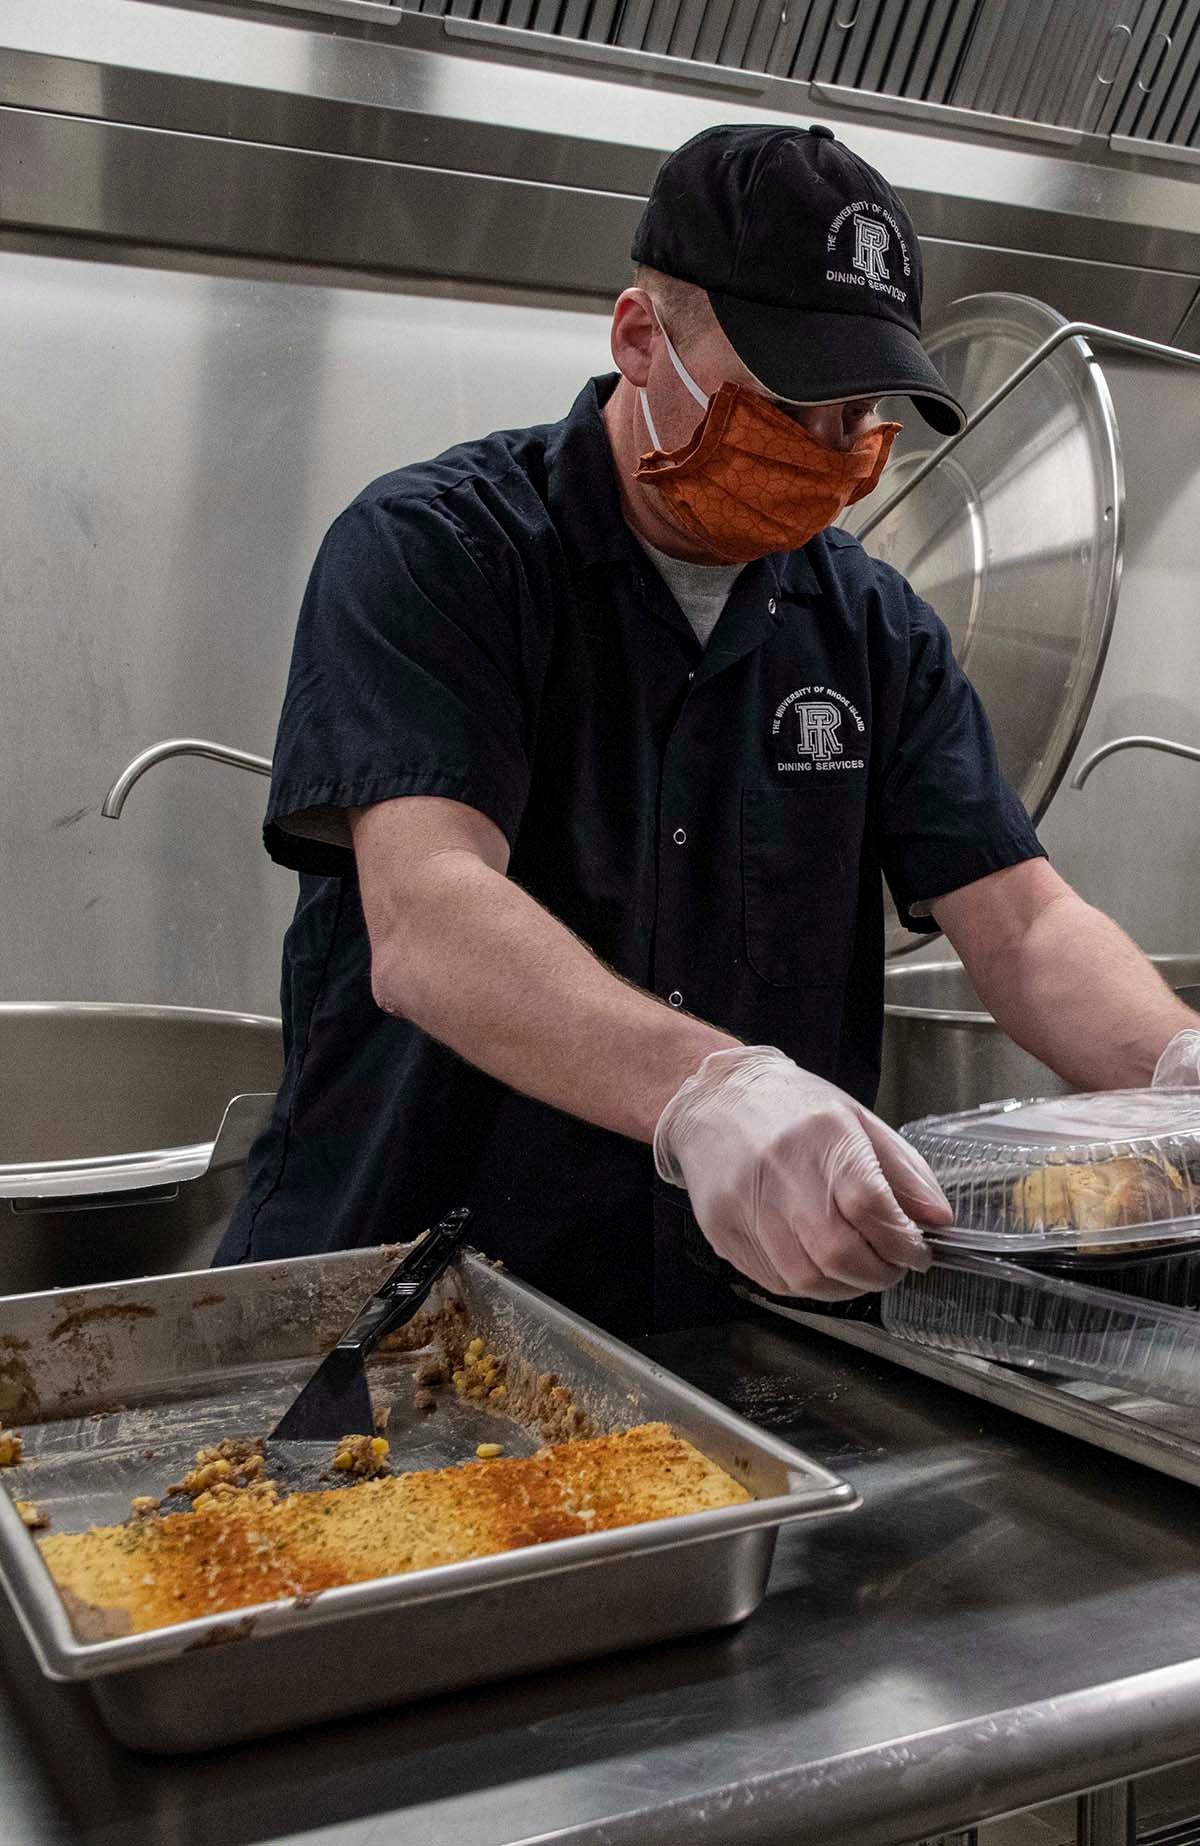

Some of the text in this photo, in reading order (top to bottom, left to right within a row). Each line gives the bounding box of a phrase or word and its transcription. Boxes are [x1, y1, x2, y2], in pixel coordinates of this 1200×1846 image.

[826, 200, 911, 277] THE UNIVERSITY OF RHODE ISLAND
[826, 270, 907, 303] DINING SERVICES
[775, 686, 812, 718] UNIVERSITY
[826, 688, 851, 707] RHODE
[772, 719, 781, 735] THE
[848, 704, 865, 732] ISLAND
[777, 759, 865, 771] DINING SERVICES
